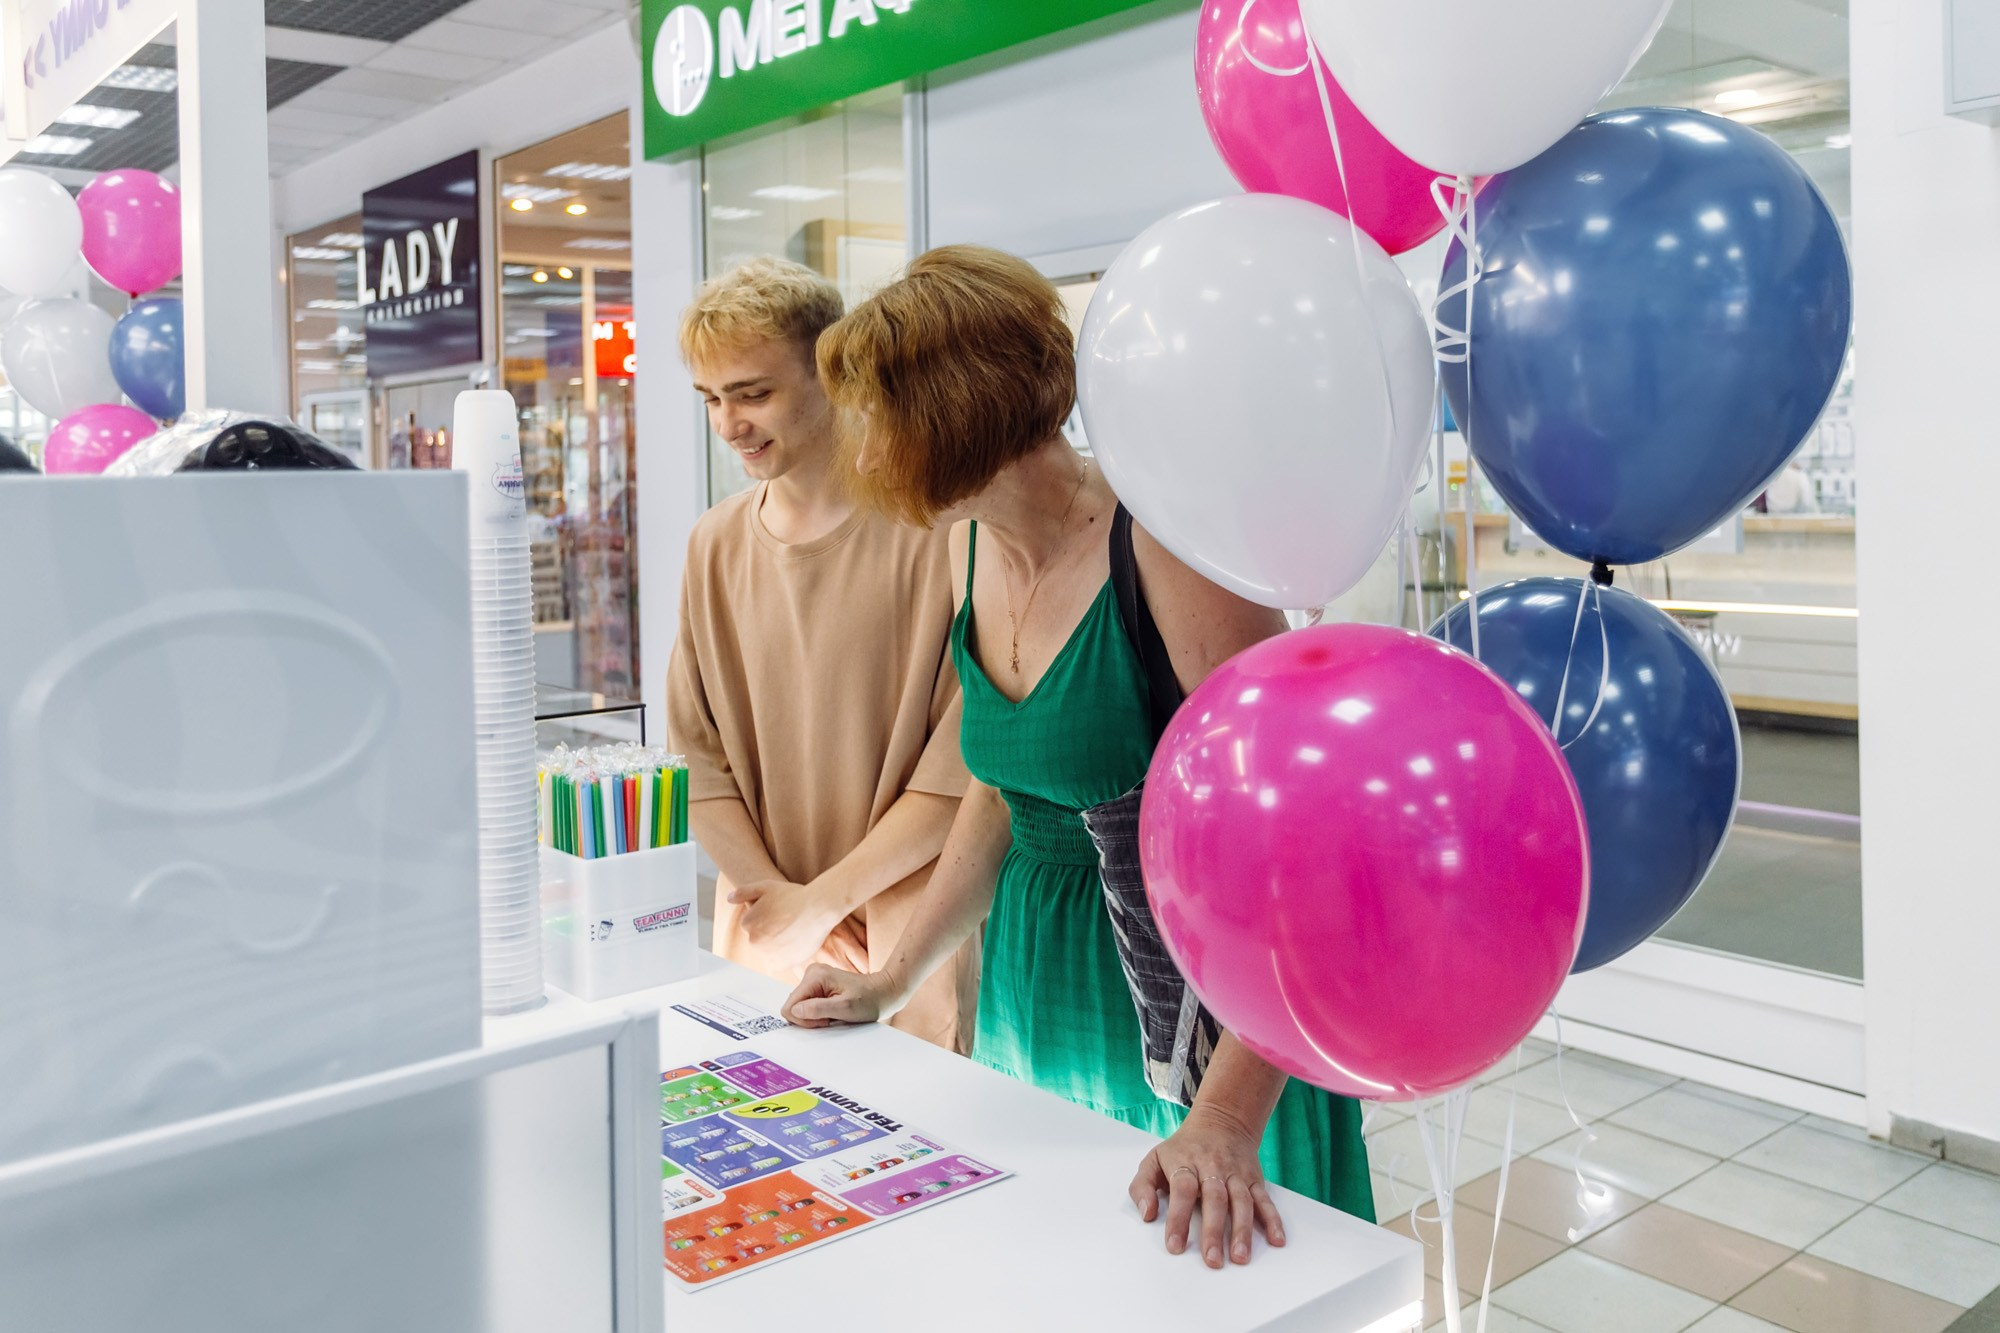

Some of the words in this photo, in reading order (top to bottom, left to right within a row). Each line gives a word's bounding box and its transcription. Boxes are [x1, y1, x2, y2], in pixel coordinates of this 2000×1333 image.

[356, 217, 459, 307] LADY
[634, 915, 654, 928] TEA
[655, 906, 687, 921] FUNNY
[864, 1111, 904, 1133] TEA
